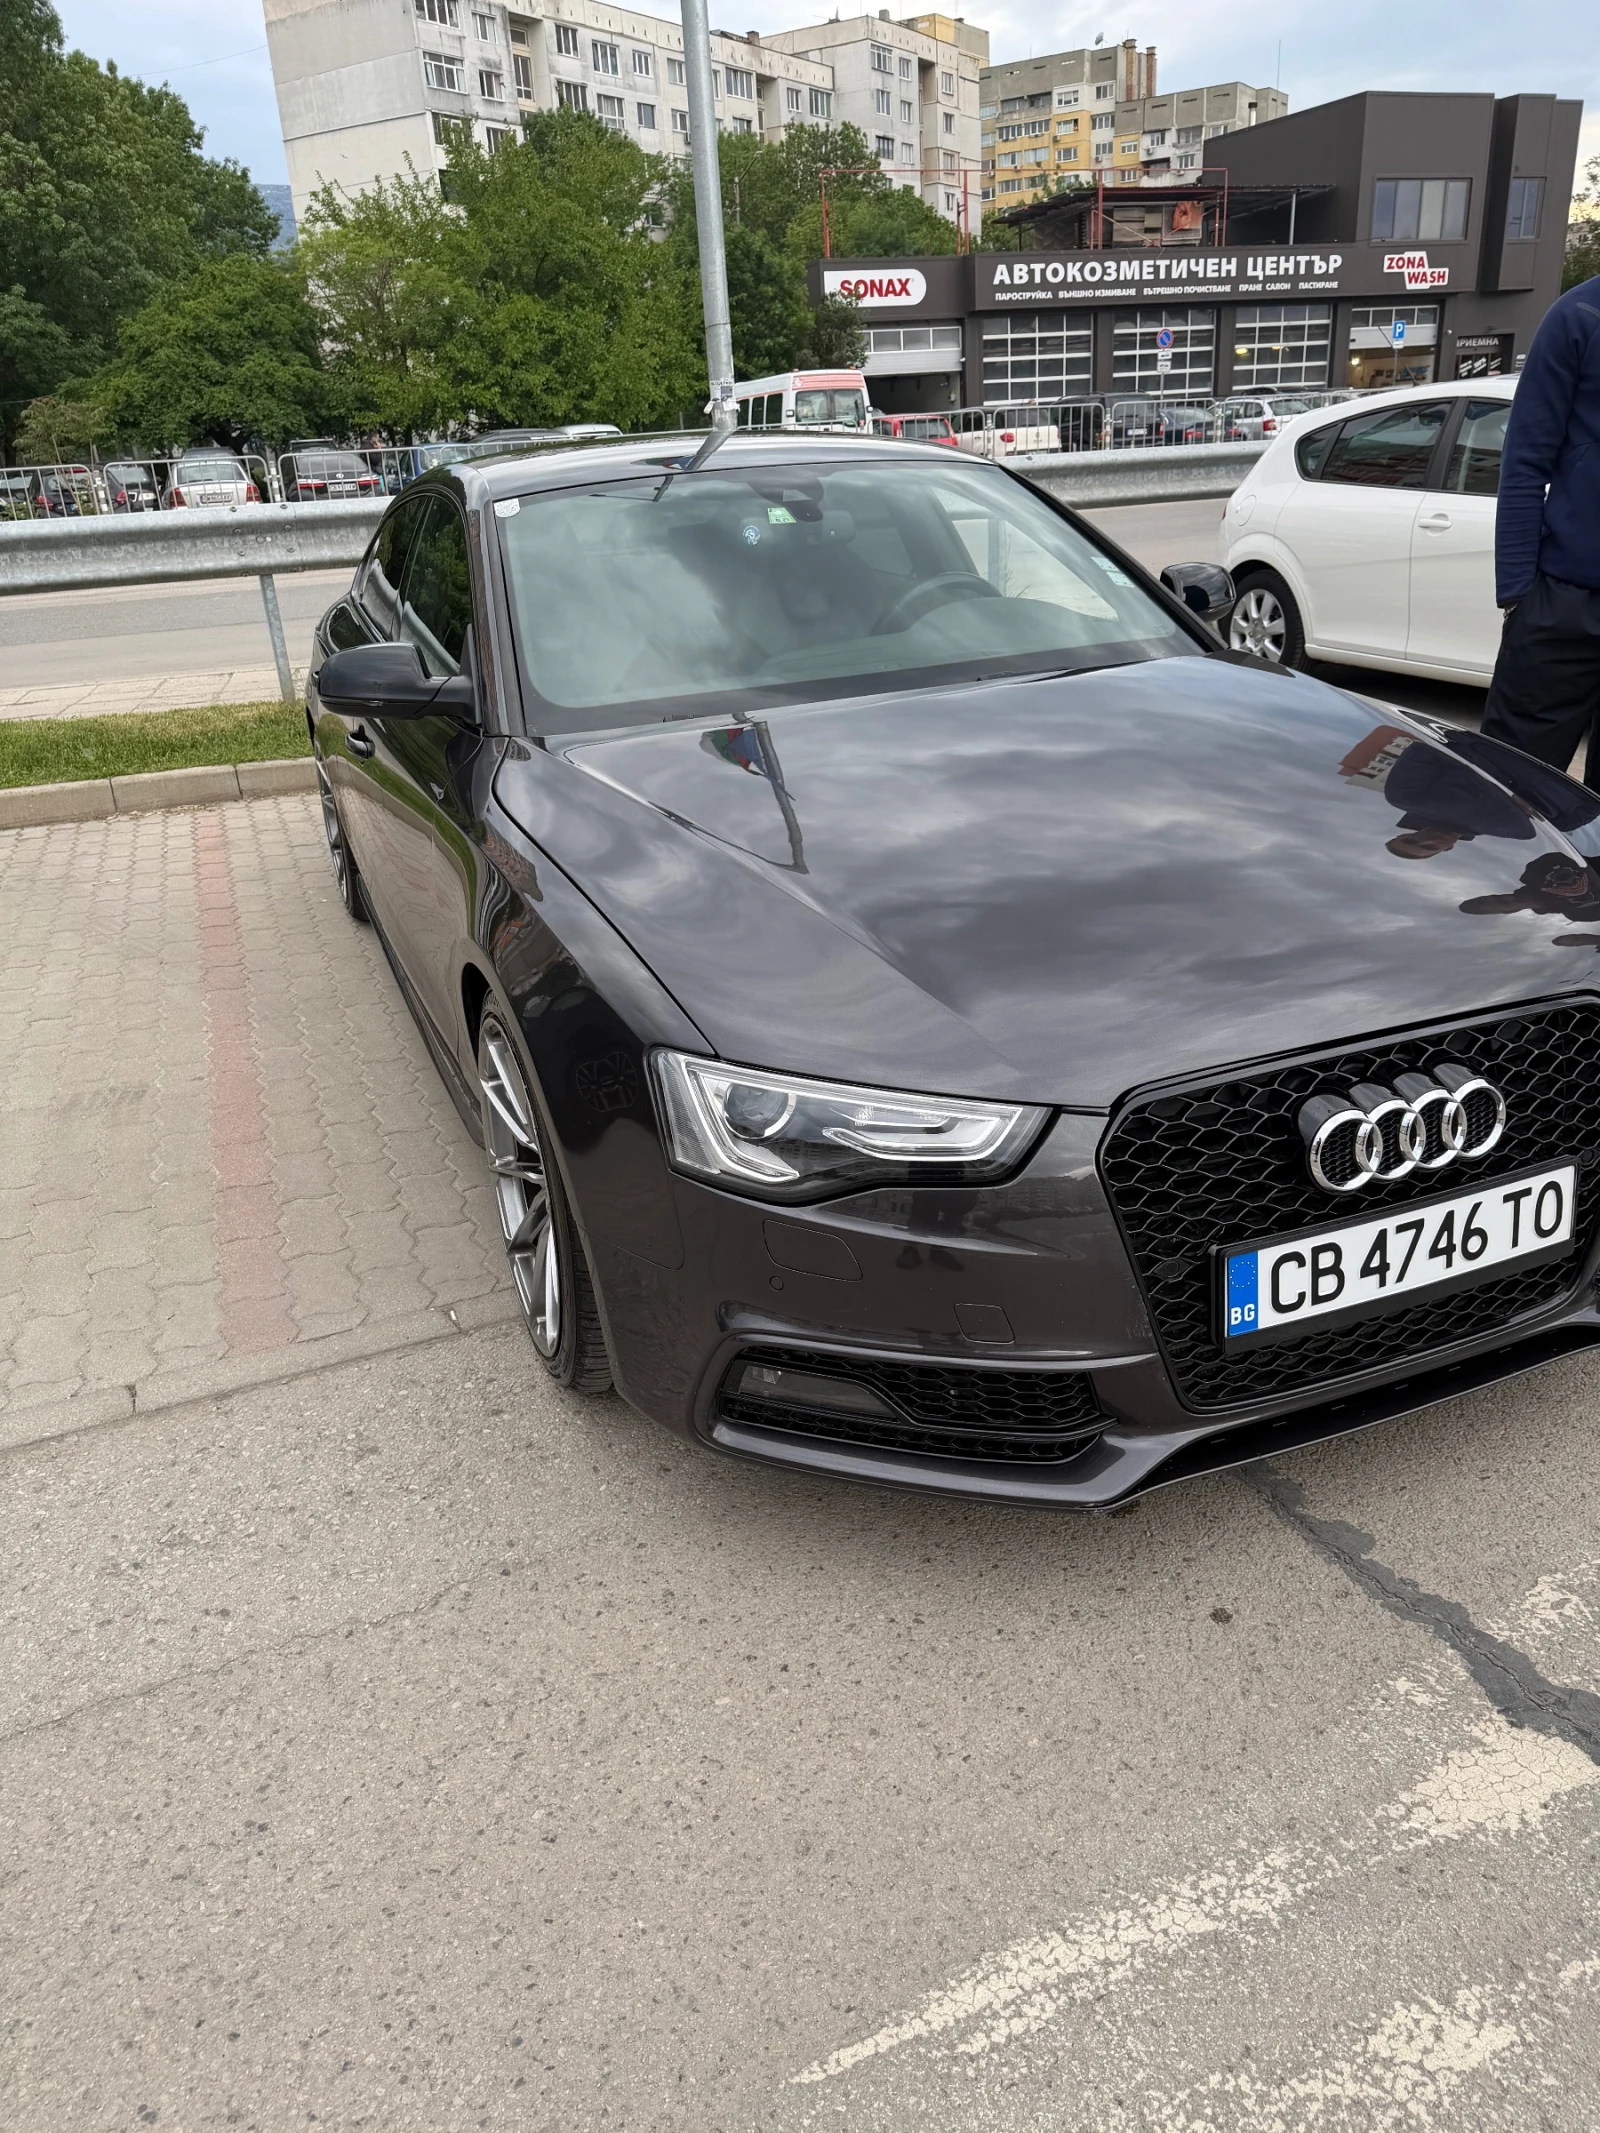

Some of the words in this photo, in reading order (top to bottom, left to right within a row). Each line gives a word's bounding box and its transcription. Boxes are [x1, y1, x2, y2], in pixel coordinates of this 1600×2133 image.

[993, 257, 1237, 285] АВТОКОЗМЕТИЧЕН
[1247, 255, 1342, 280] ЦЕНТЪР
[1386, 256, 1425, 269] ZONA
[1407, 271, 1446, 284] WASH
[840, 278, 911, 299] SONAX
[995, 290, 1053, 301] ПАРОСТРУЙКА
[1058, 289, 1094, 299] ВЪНШНО
[1095, 288, 1137, 298] ИЗМИВАНЕ
[1184, 284, 1231, 294] ПОЧИСТВАНЕ
[1239, 283, 1262, 292] ПРАНЕ
[1266, 282, 1291, 291] САЛОН
[1298, 281, 1339, 290] ПАСТИРАНЕ
[1396, 323, 1404, 338] P
[1271, 1242, 1345, 1314] CB
[1359, 1201, 1489, 1289] 4746
[1230, 1303, 1256, 1327] BG
